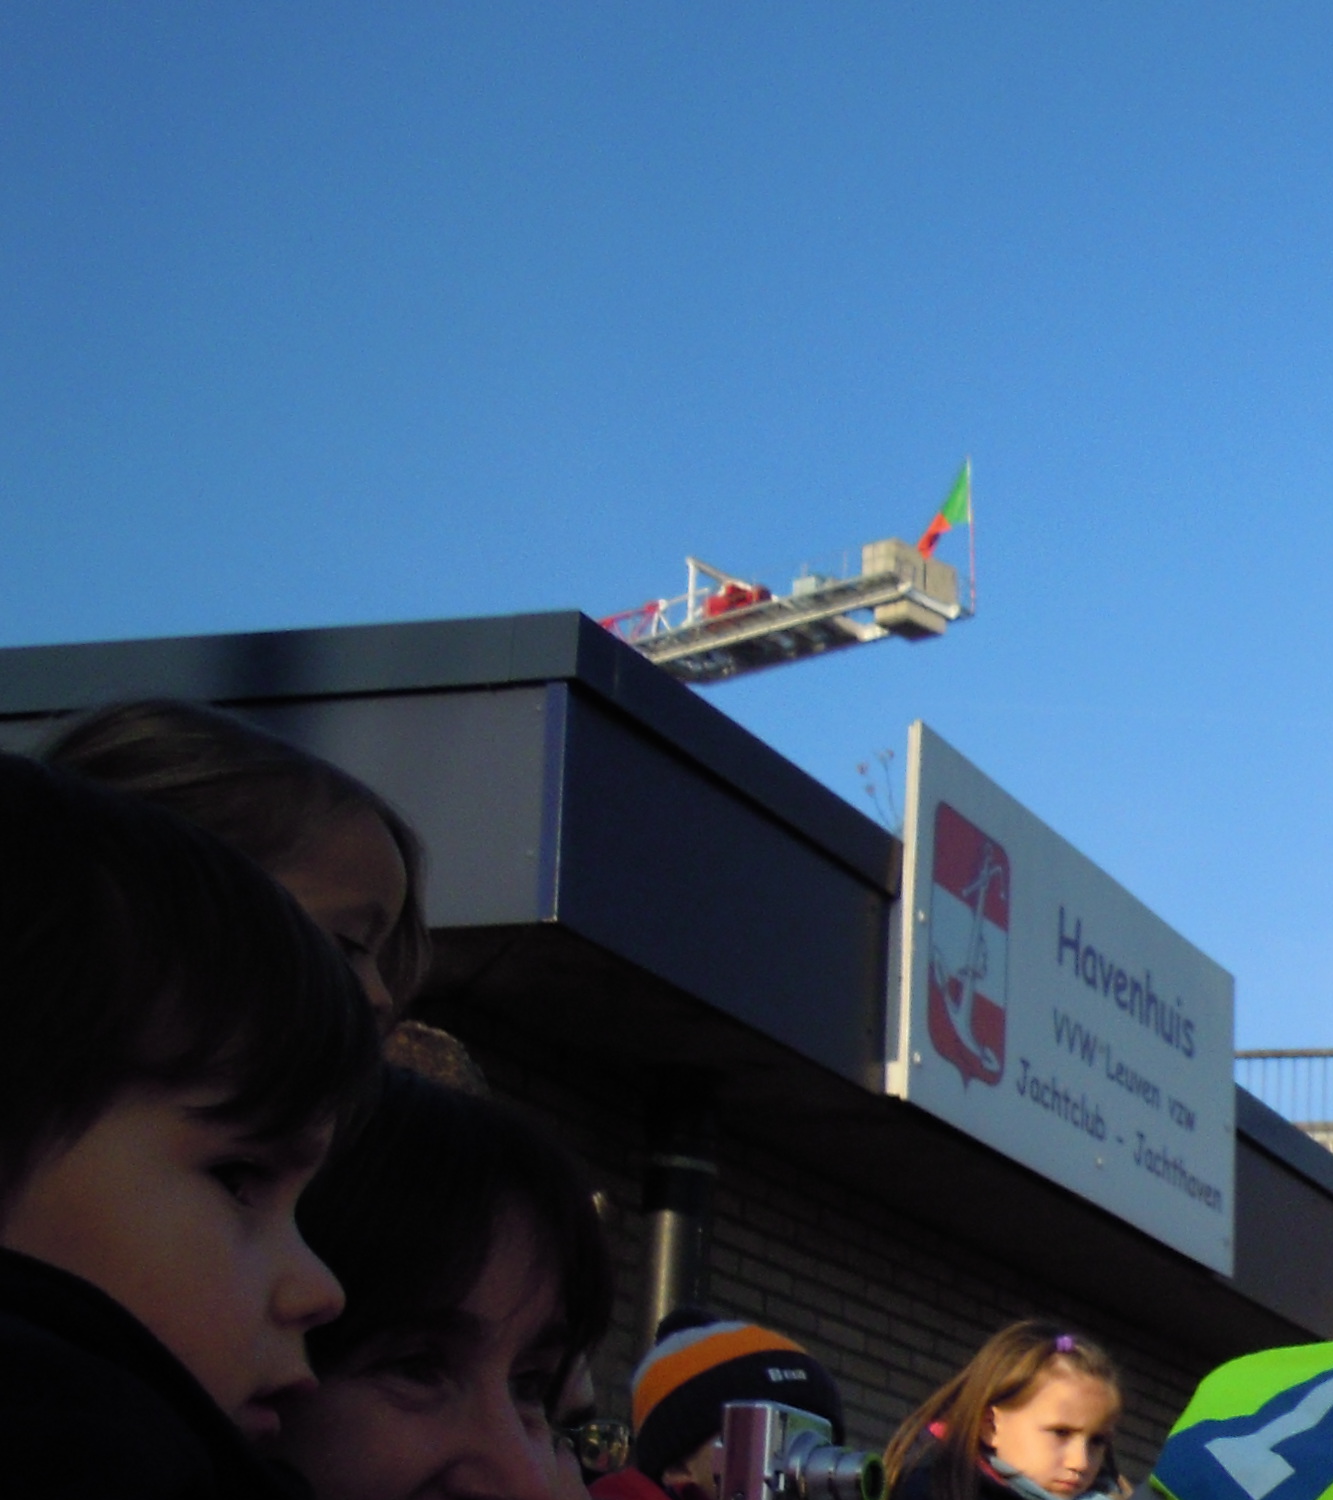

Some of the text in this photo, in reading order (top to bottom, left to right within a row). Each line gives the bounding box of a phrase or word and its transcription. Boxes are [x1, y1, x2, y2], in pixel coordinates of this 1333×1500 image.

[1056, 905, 1196, 1059] Havenhuis
[1016, 1057, 1107, 1142] Jachtclub
[1132, 1130, 1224, 1212] Jachthaven
[1053, 1006, 1196, 1132] VVW Leuven vzw
